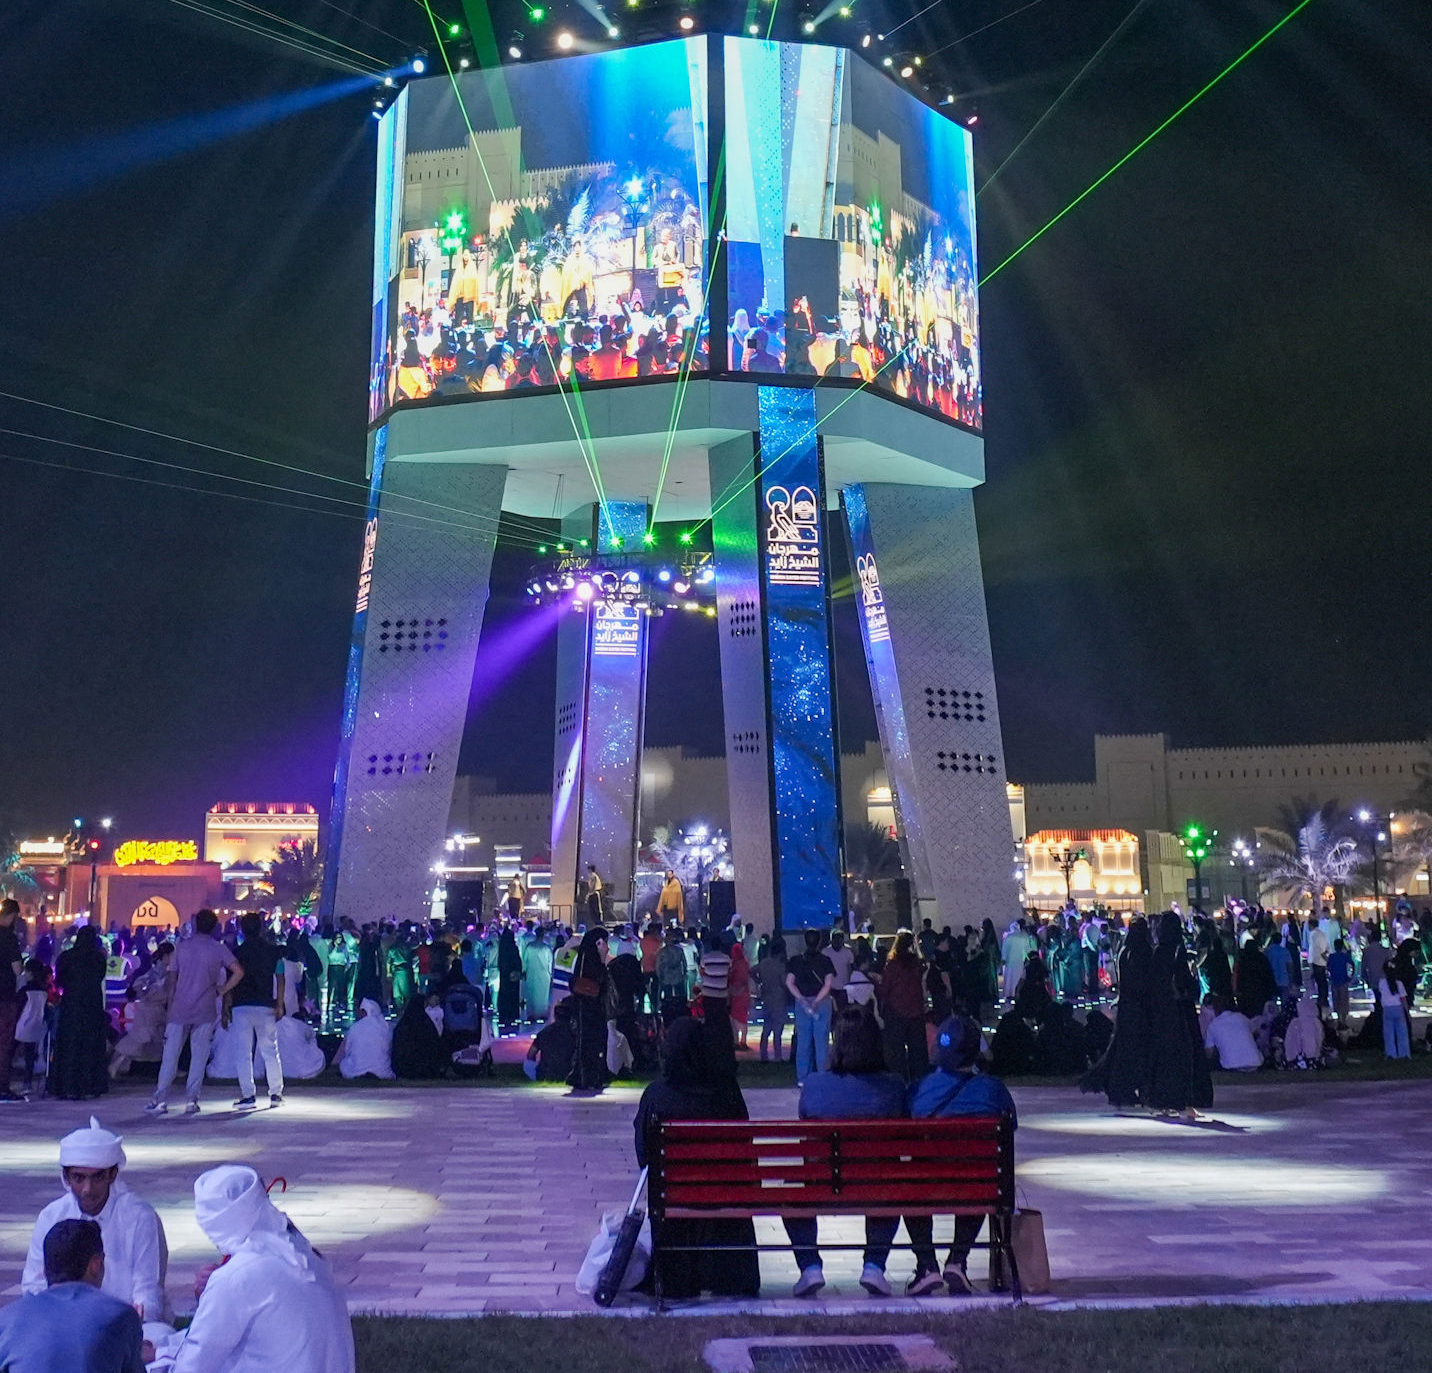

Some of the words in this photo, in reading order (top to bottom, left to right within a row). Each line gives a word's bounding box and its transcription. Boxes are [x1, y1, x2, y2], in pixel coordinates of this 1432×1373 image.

[768, 542, 819, 557] مهرجان
[769, 555, 787, 569] زايد
[788, 555, 819, 570] الشيخ
